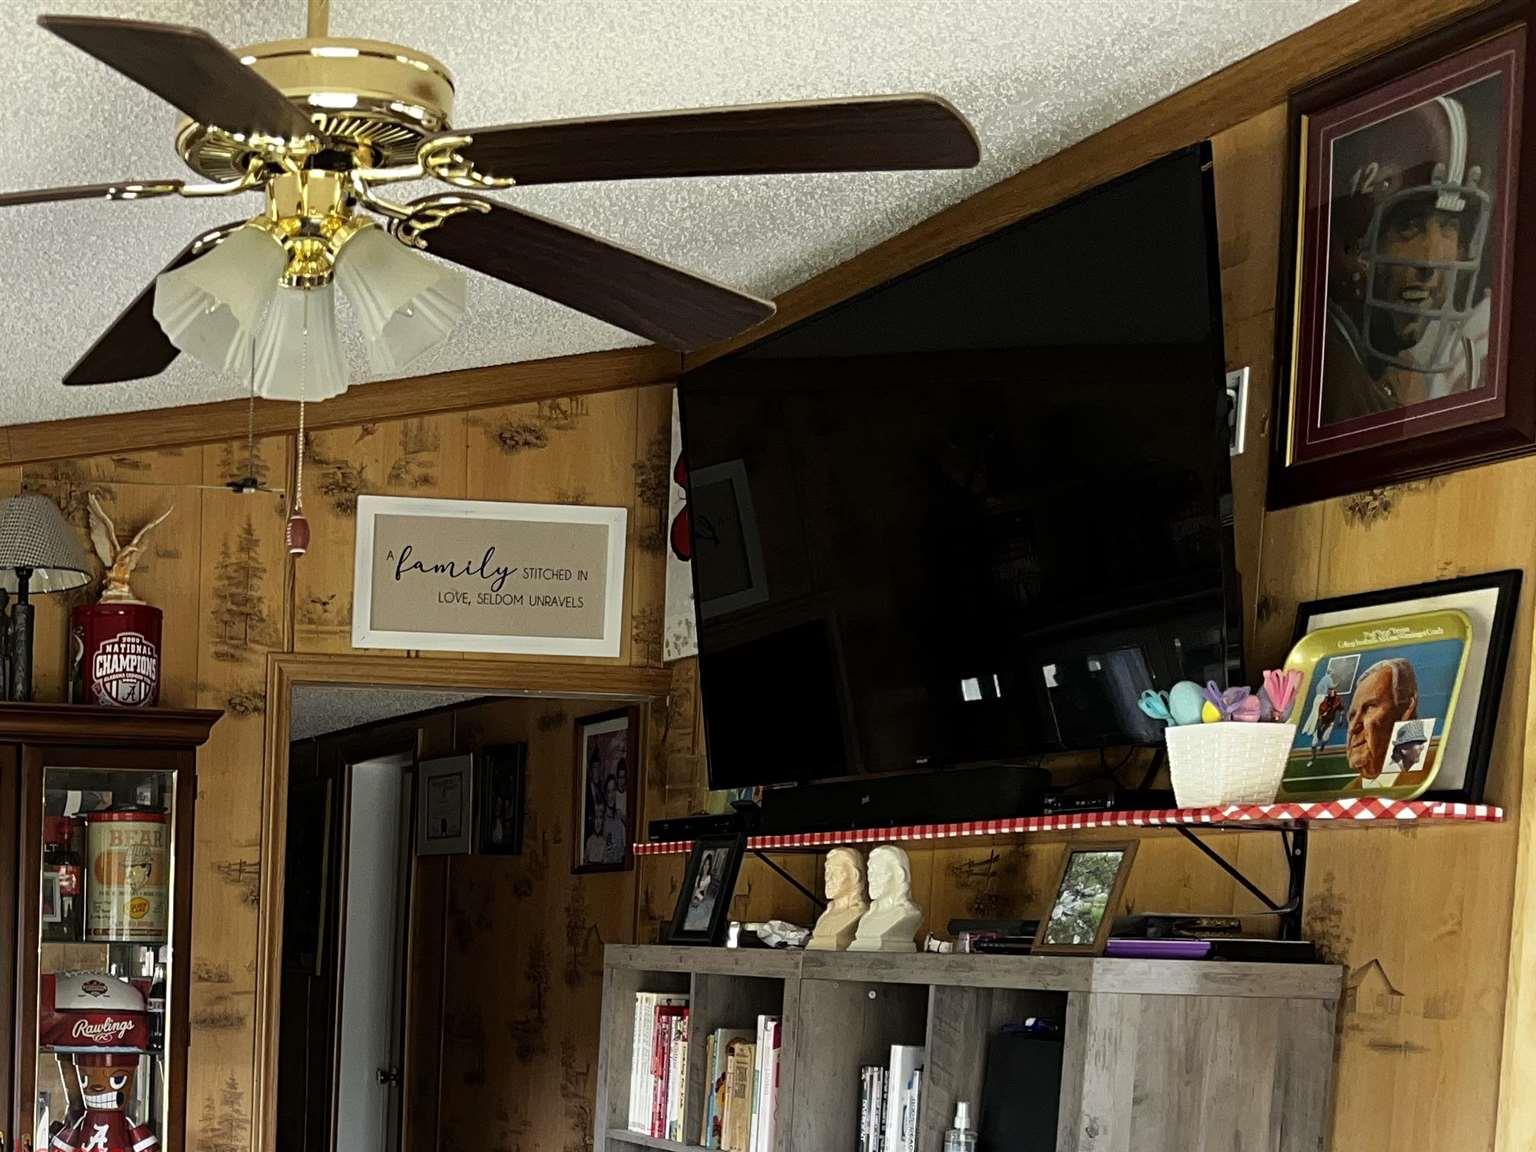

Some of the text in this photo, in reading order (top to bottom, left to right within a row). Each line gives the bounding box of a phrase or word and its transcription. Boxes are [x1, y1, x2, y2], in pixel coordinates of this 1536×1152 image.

[386, 545, 588, 593] A family STITCHED IN
[438, 591, 584, 608] LOVE, SELDOM UNRAVELS
[106, 643, 152, 656] NATIONAL
[95, 653, 156, 681] CHAMPIONS
[72, 1016, 135, 1039] Rawlings
